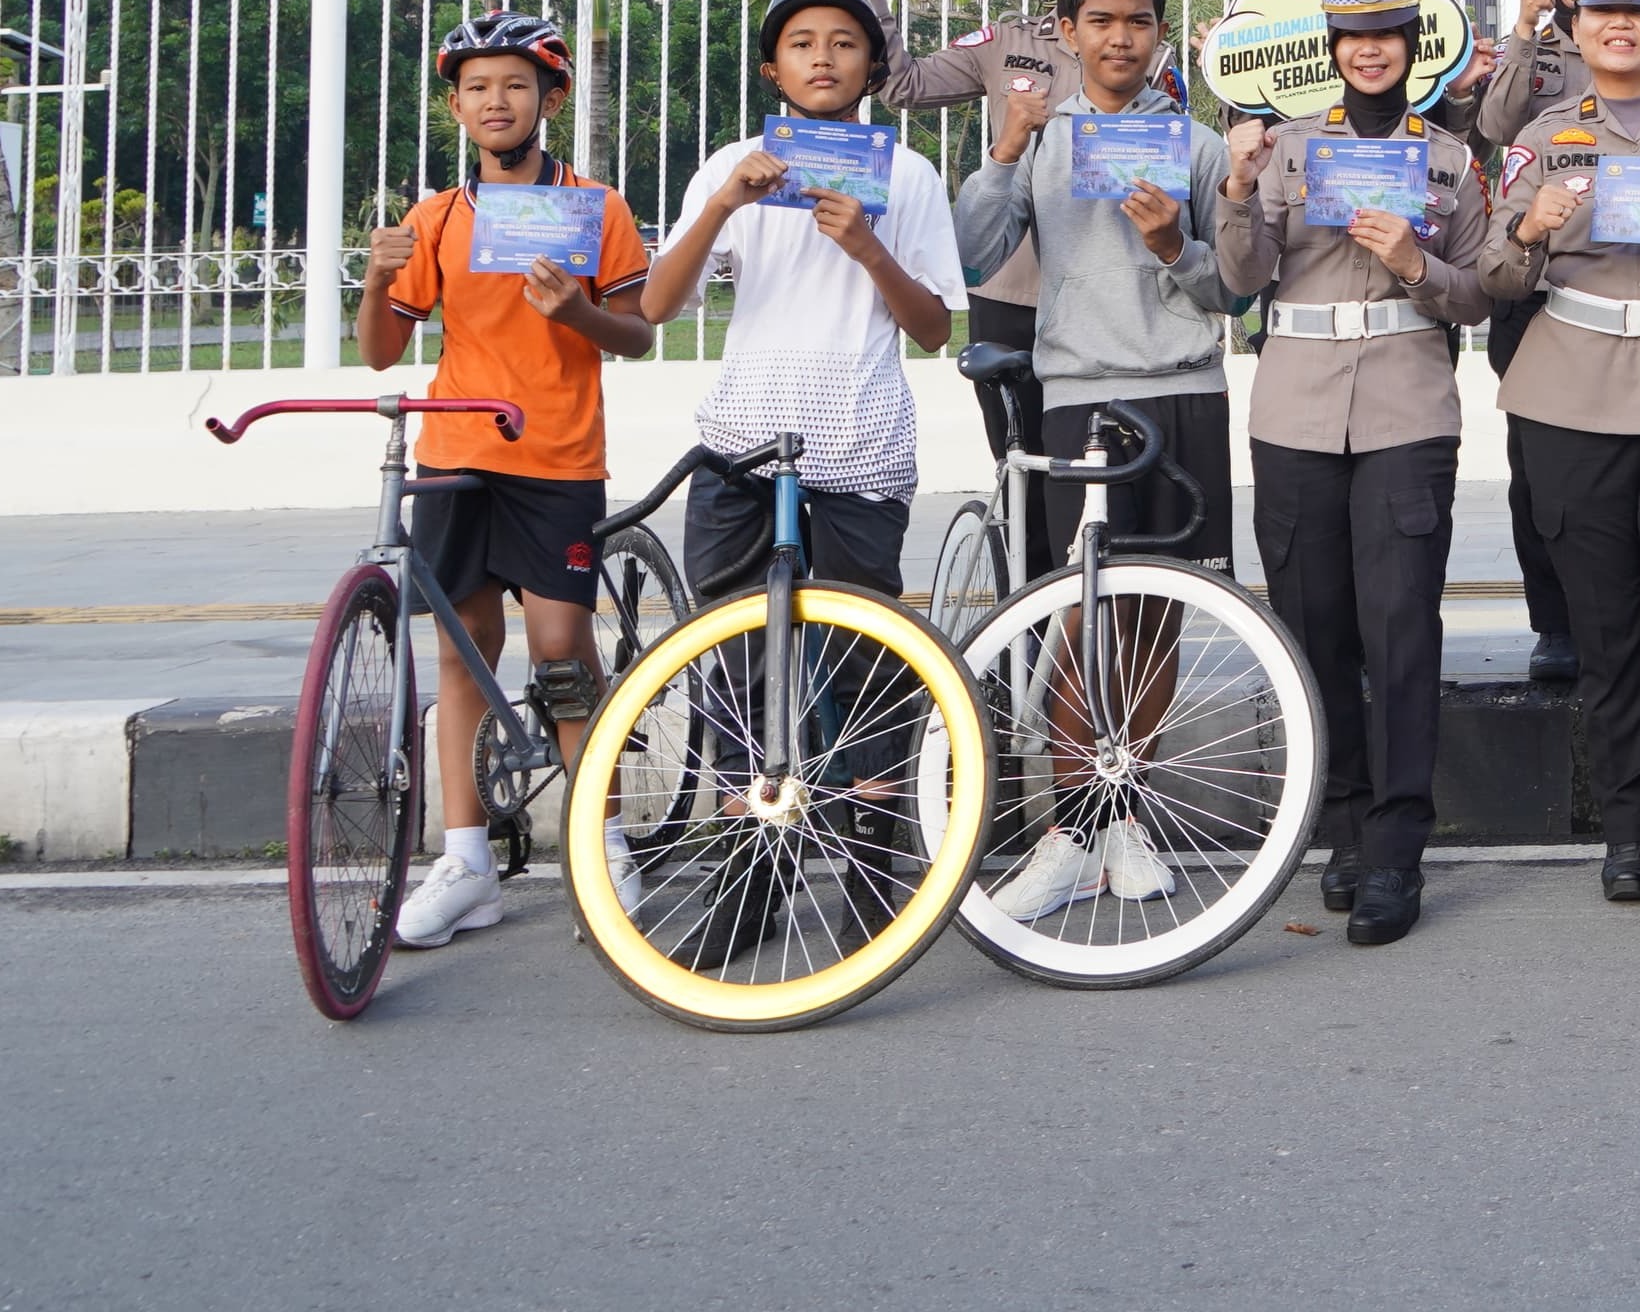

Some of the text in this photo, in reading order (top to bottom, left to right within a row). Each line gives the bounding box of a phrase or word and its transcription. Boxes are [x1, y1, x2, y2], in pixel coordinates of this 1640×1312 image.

[1218, 28, 1271, 50] PILKADA
[1274, 16, 1314, 39] DAMAI
[1004, 54, 1054, 77] RIZKA
[1220, 36, 1320, 77] BUDAYAKAN
[1273, 58, 1341, 92] SEBAGA
